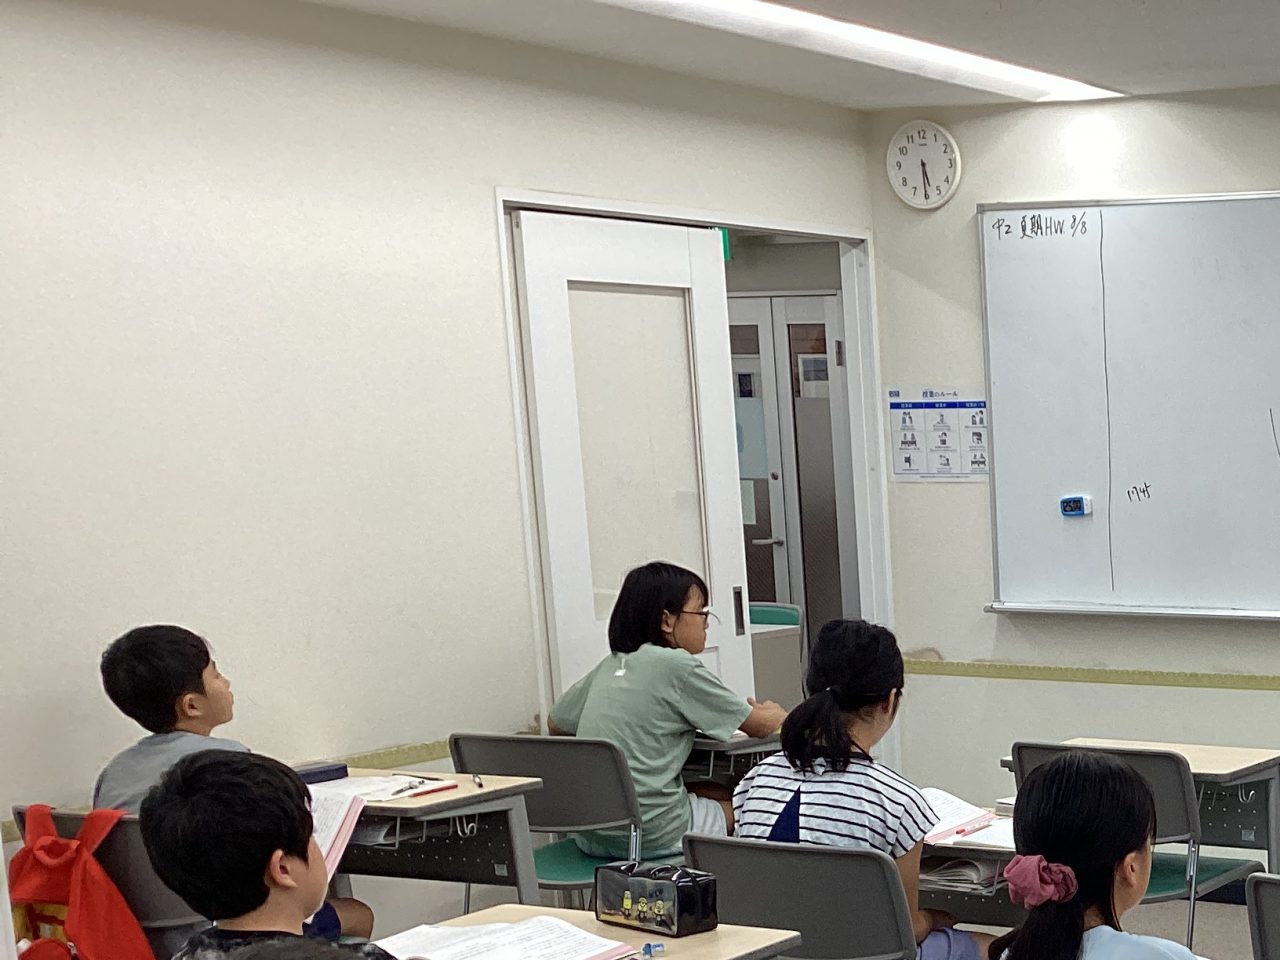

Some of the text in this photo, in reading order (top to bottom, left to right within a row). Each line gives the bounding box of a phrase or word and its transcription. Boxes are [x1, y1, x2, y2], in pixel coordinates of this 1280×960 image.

[906, 134, 914, 144] 11
[917, 129, 927, 140] 12
[933, 133, 937, 142] 1
[898, 145, 908, 156] 10
[942, 143, 949, 154] 2
[896, 160, 902, 171] 9
[947, 158, 953, 169] 3
[901, 176, 908, 187] 8
[943, 175, 950, 185] 4
[911, 186, 917, 196] 7
[936, 185, 942, 196] 5
[1070, 211, 1088, 238] 8/8
